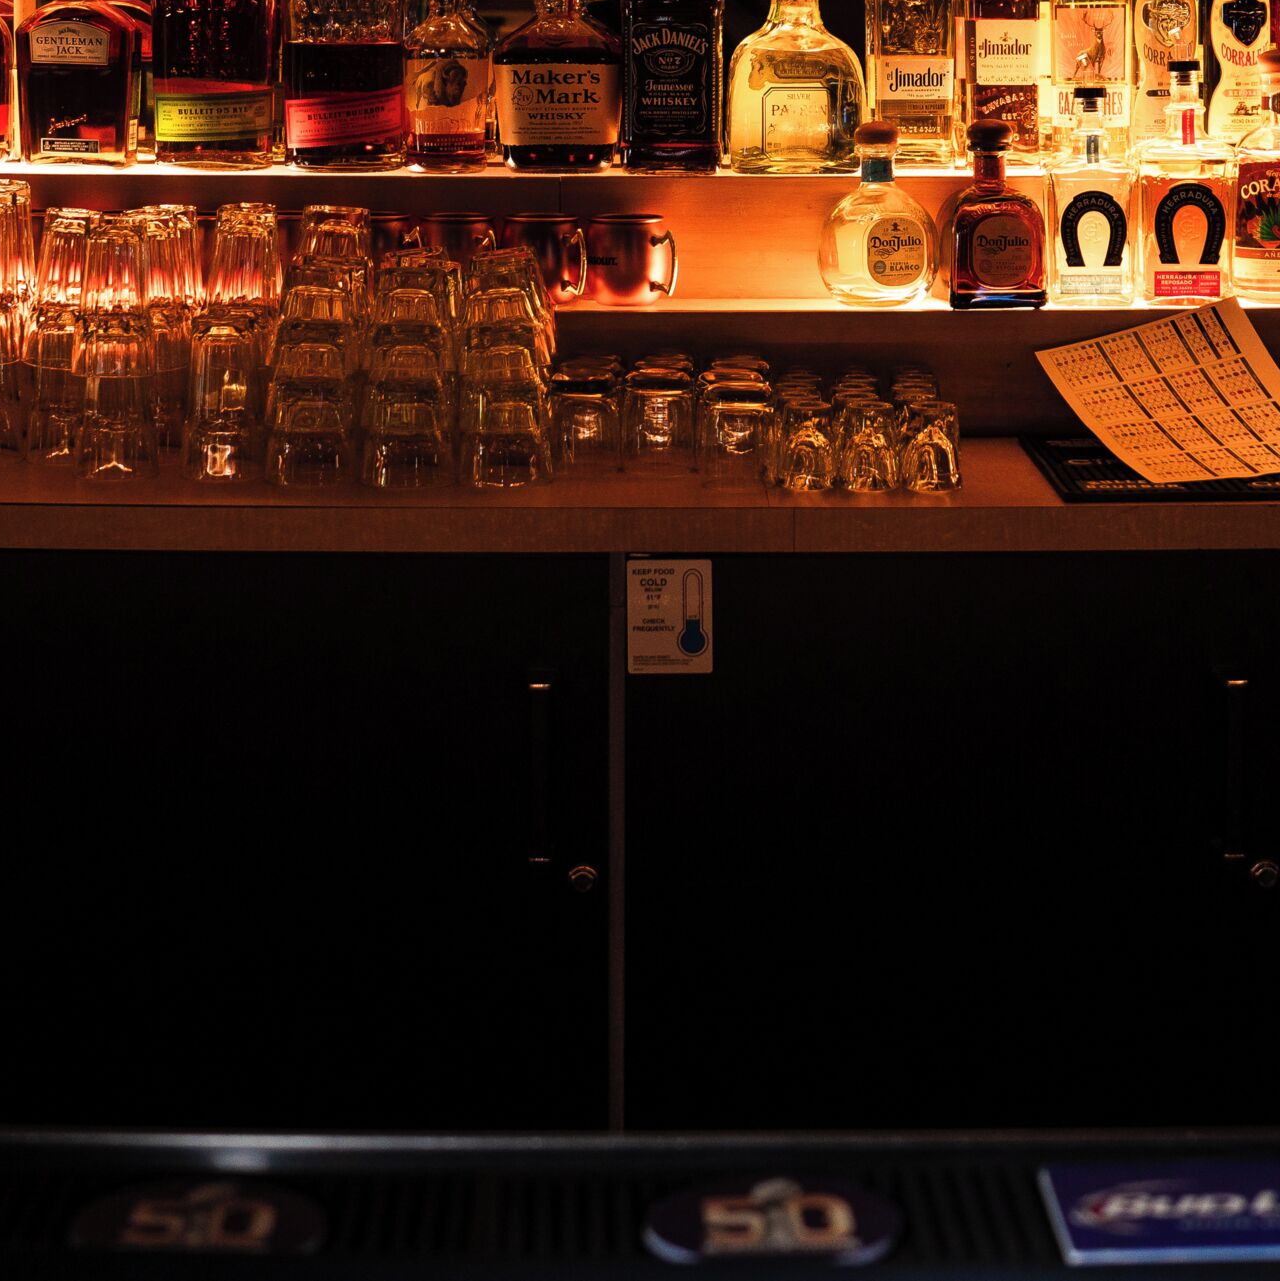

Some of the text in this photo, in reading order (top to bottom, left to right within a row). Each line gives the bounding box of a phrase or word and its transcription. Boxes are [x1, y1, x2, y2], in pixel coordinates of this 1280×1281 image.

[35, 37, 103, 46] GENTLEMAN
[631, 27, 710, 57] JACK DANIEL'S
[980, 38, 1033, 61] Jimador
[55, 46, 83, 56] JACK
[511, 68, 601, 85] Maker's
[889, 67, 946, 92] Jimador
[643, 79, 695, 92] Tennessee
[535, 87, 600, 104] Mark
[640, 95, 699, 107] WHISKEY
[177, 106, 214, 115] BULLEIT
[307, 105, 386, 121] BULLEIT BOURBON
[527, 112, 587, 120] WHISKY
[1065, 199, 1120, 220] HERRADURA
[1160, 190, 1219, 215] HERRADURA
[870, 234, 922, 252] Don Julio
[976, 234, 1030, 252] Don Julio
[639, 578, 668, 586] COLD
